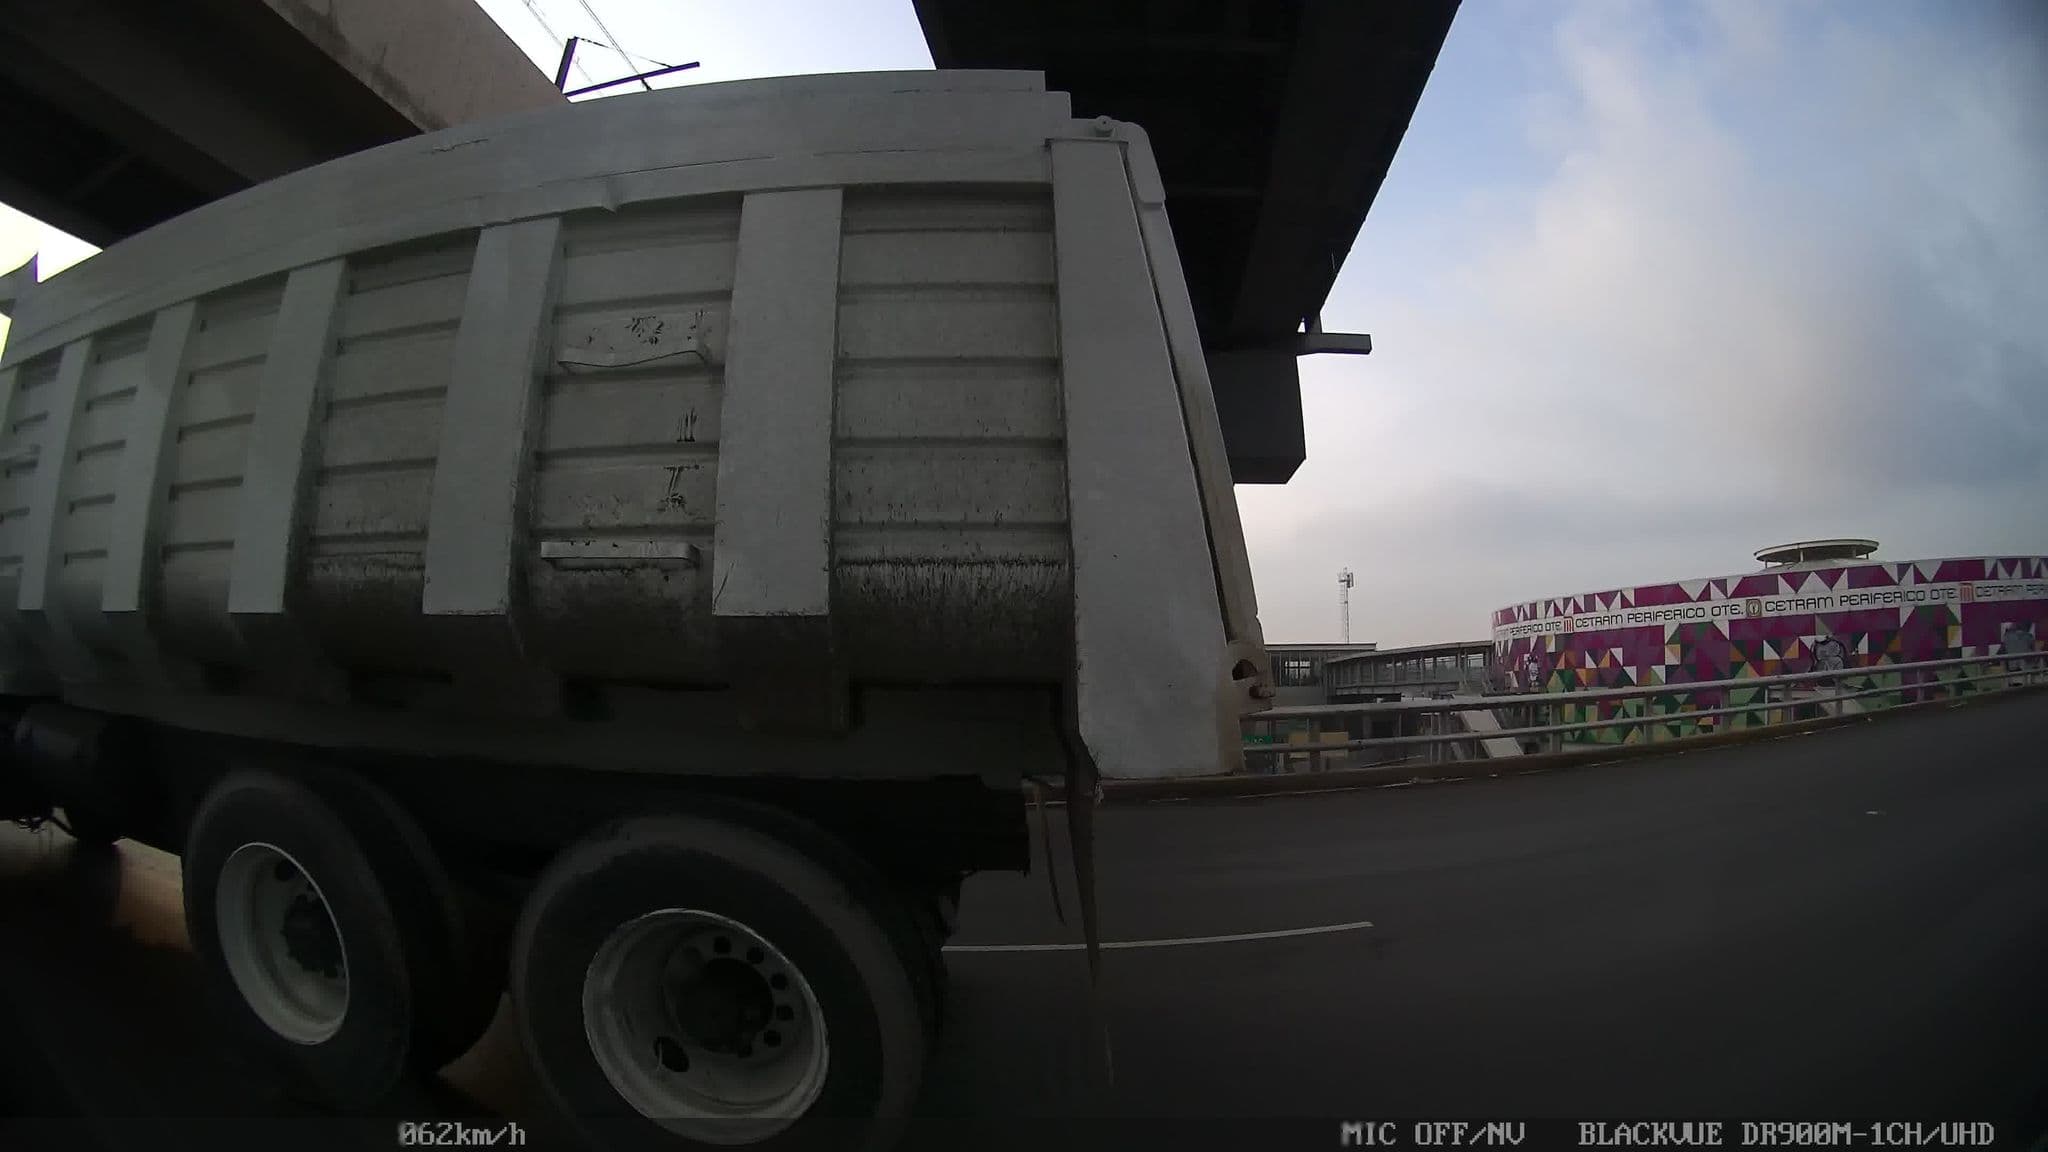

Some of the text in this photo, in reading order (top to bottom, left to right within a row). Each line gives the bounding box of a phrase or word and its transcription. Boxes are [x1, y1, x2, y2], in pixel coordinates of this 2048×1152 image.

[1575, 615, 1624, 629] CETRAM
[1627, 606, 1705, 624] PERIFERICO
[1711, 604, 1744, 617] OTE.
[1765, 596, 1834, 613] CETRAM
[1840, 590, 1925, 607] PERIFERICO
